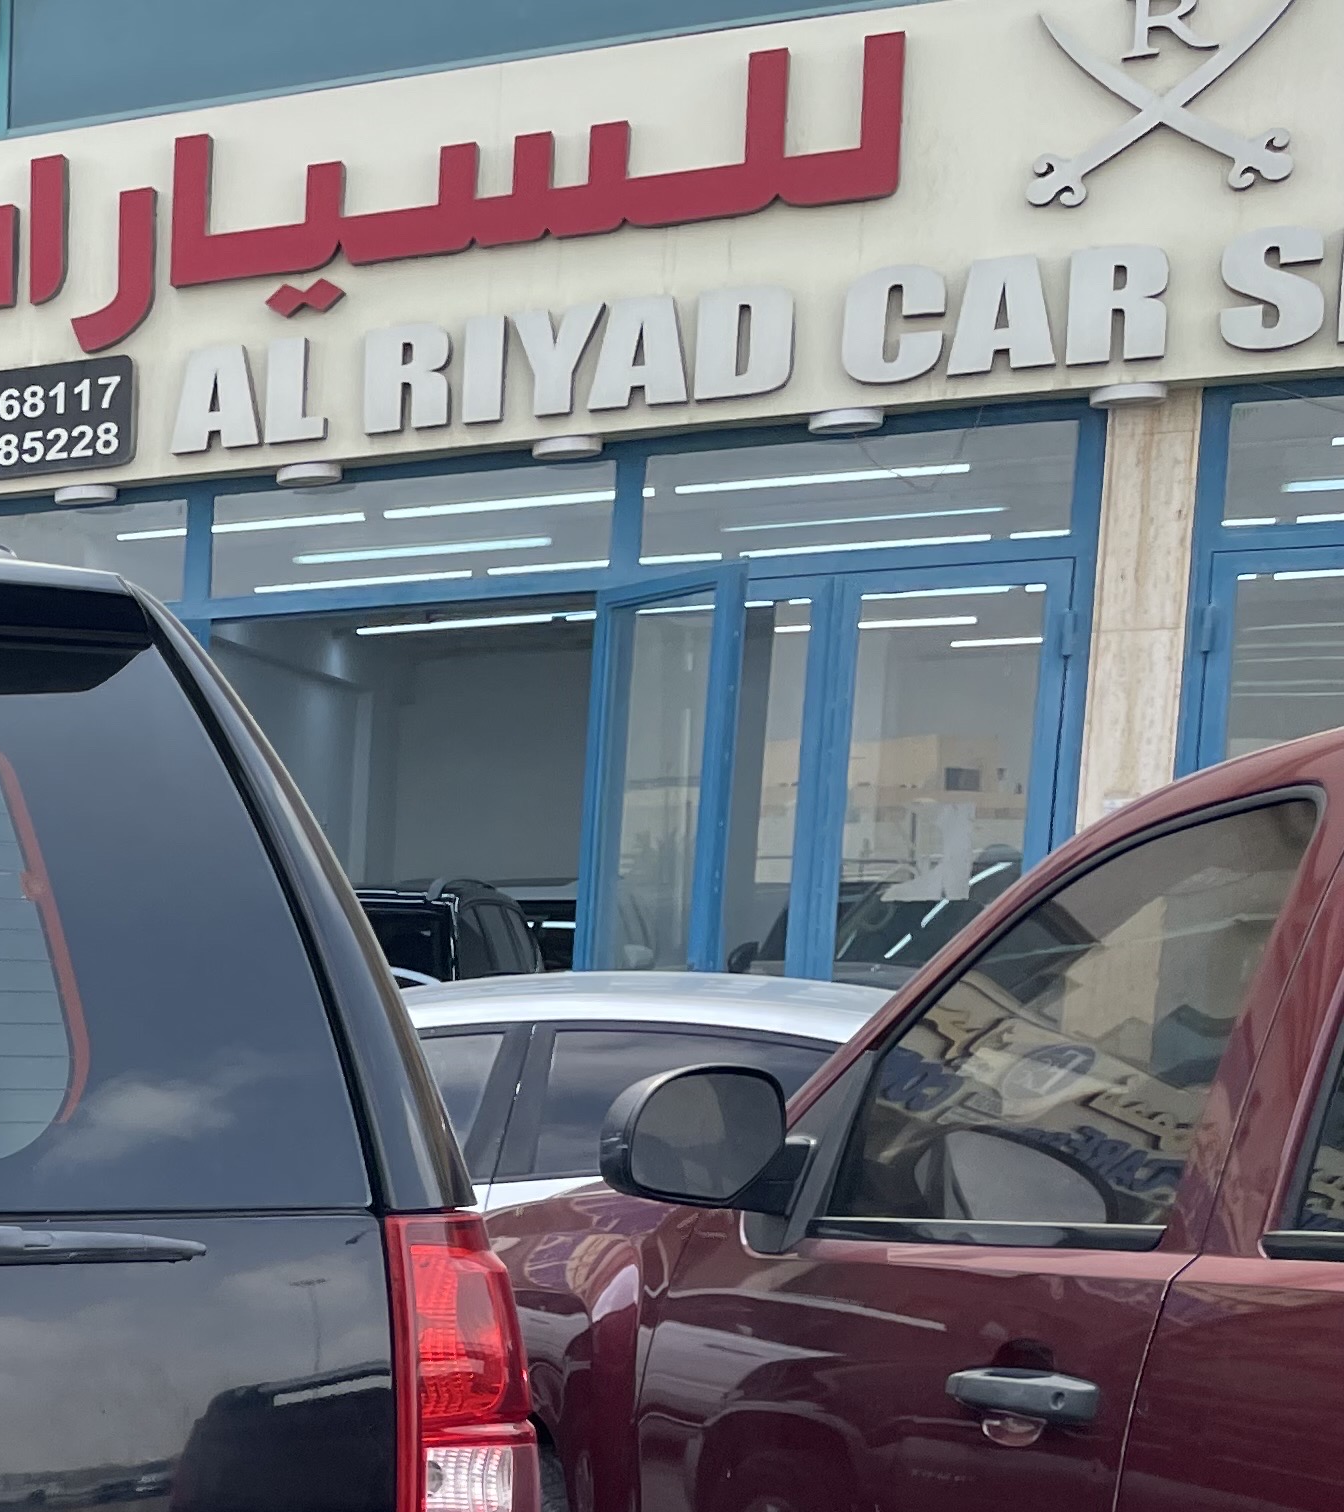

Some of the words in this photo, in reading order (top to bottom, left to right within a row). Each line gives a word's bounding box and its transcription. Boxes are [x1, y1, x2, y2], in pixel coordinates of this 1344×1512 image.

[170, 337, 328, 455] AL
[363, 286, 795, 436] RIYAD
[841, 244, 1170, 386] CAR
[1220, 225, 1344, 352] S
